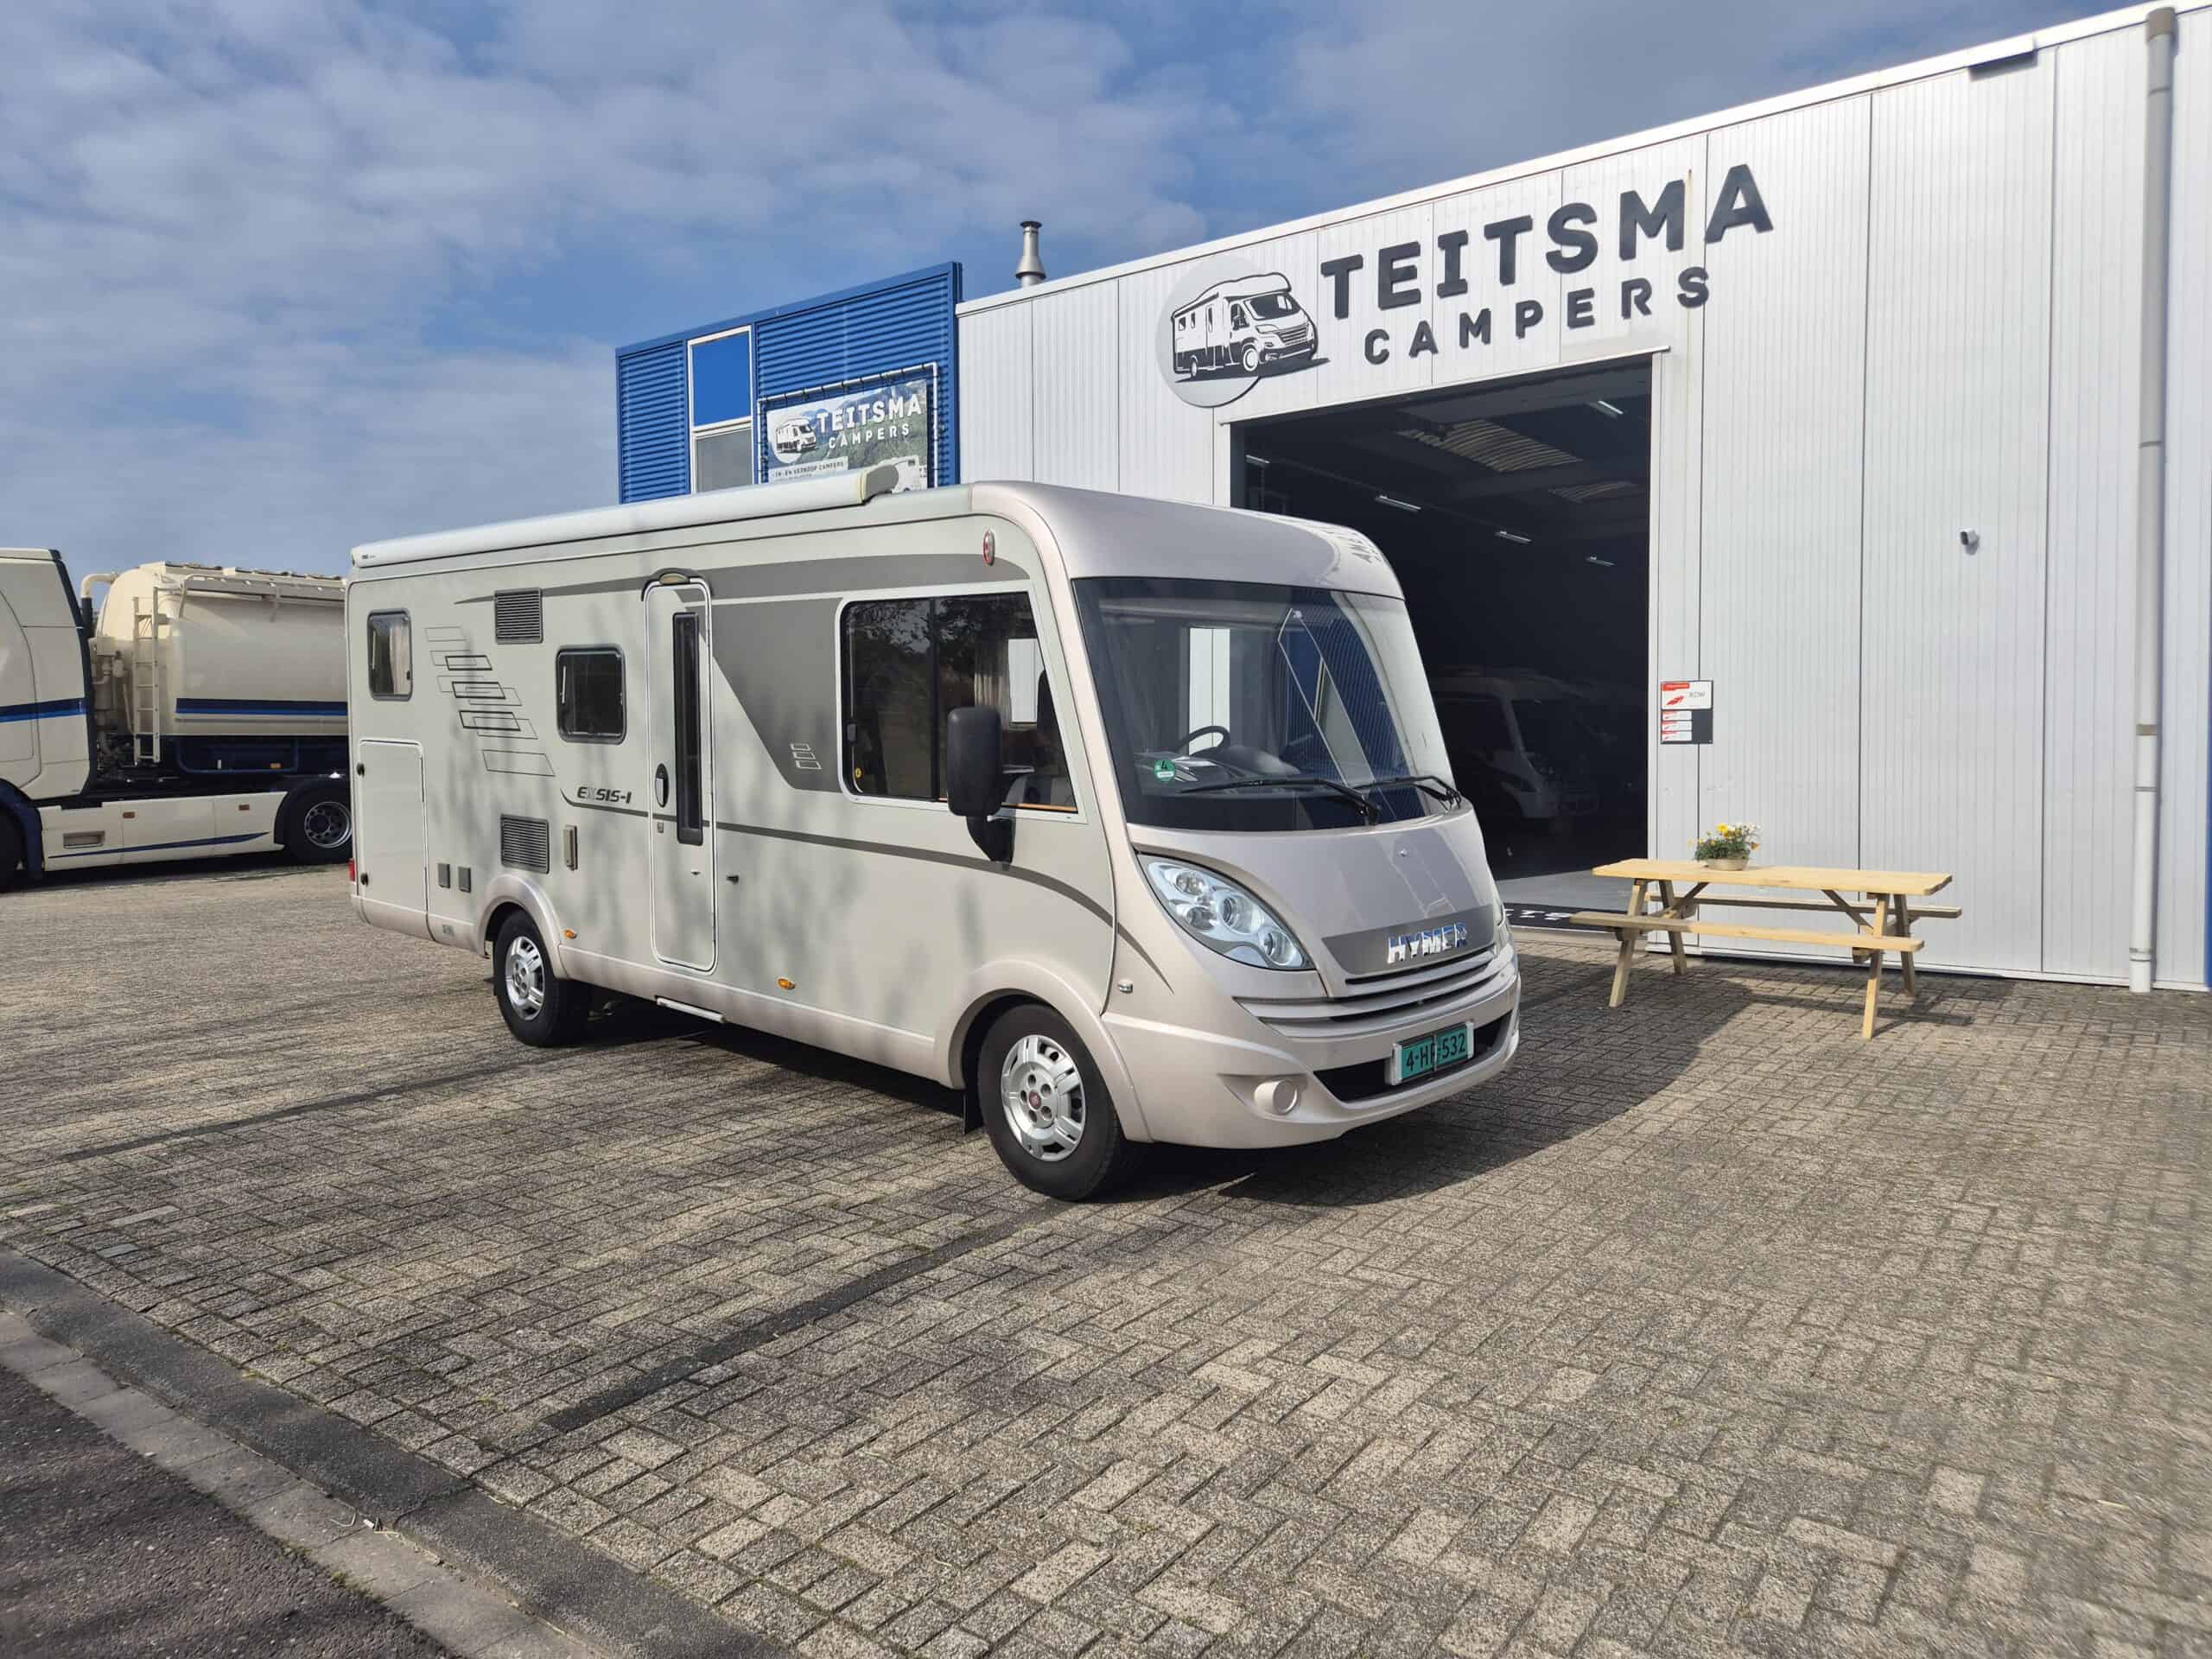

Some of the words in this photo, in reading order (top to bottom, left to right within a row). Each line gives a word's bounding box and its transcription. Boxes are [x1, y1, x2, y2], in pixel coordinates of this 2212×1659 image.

[1321, 164, 1773, 320] TEITSMA
[1364, 266, 1709, 365] CAMPERS
[817, 394, 922, 434] TEITSMA
[829, 423, 910, 449] CAMPERS
[1161, 760, 1168, 770] 4
[1387, 922, 1467, 964] HYMER
